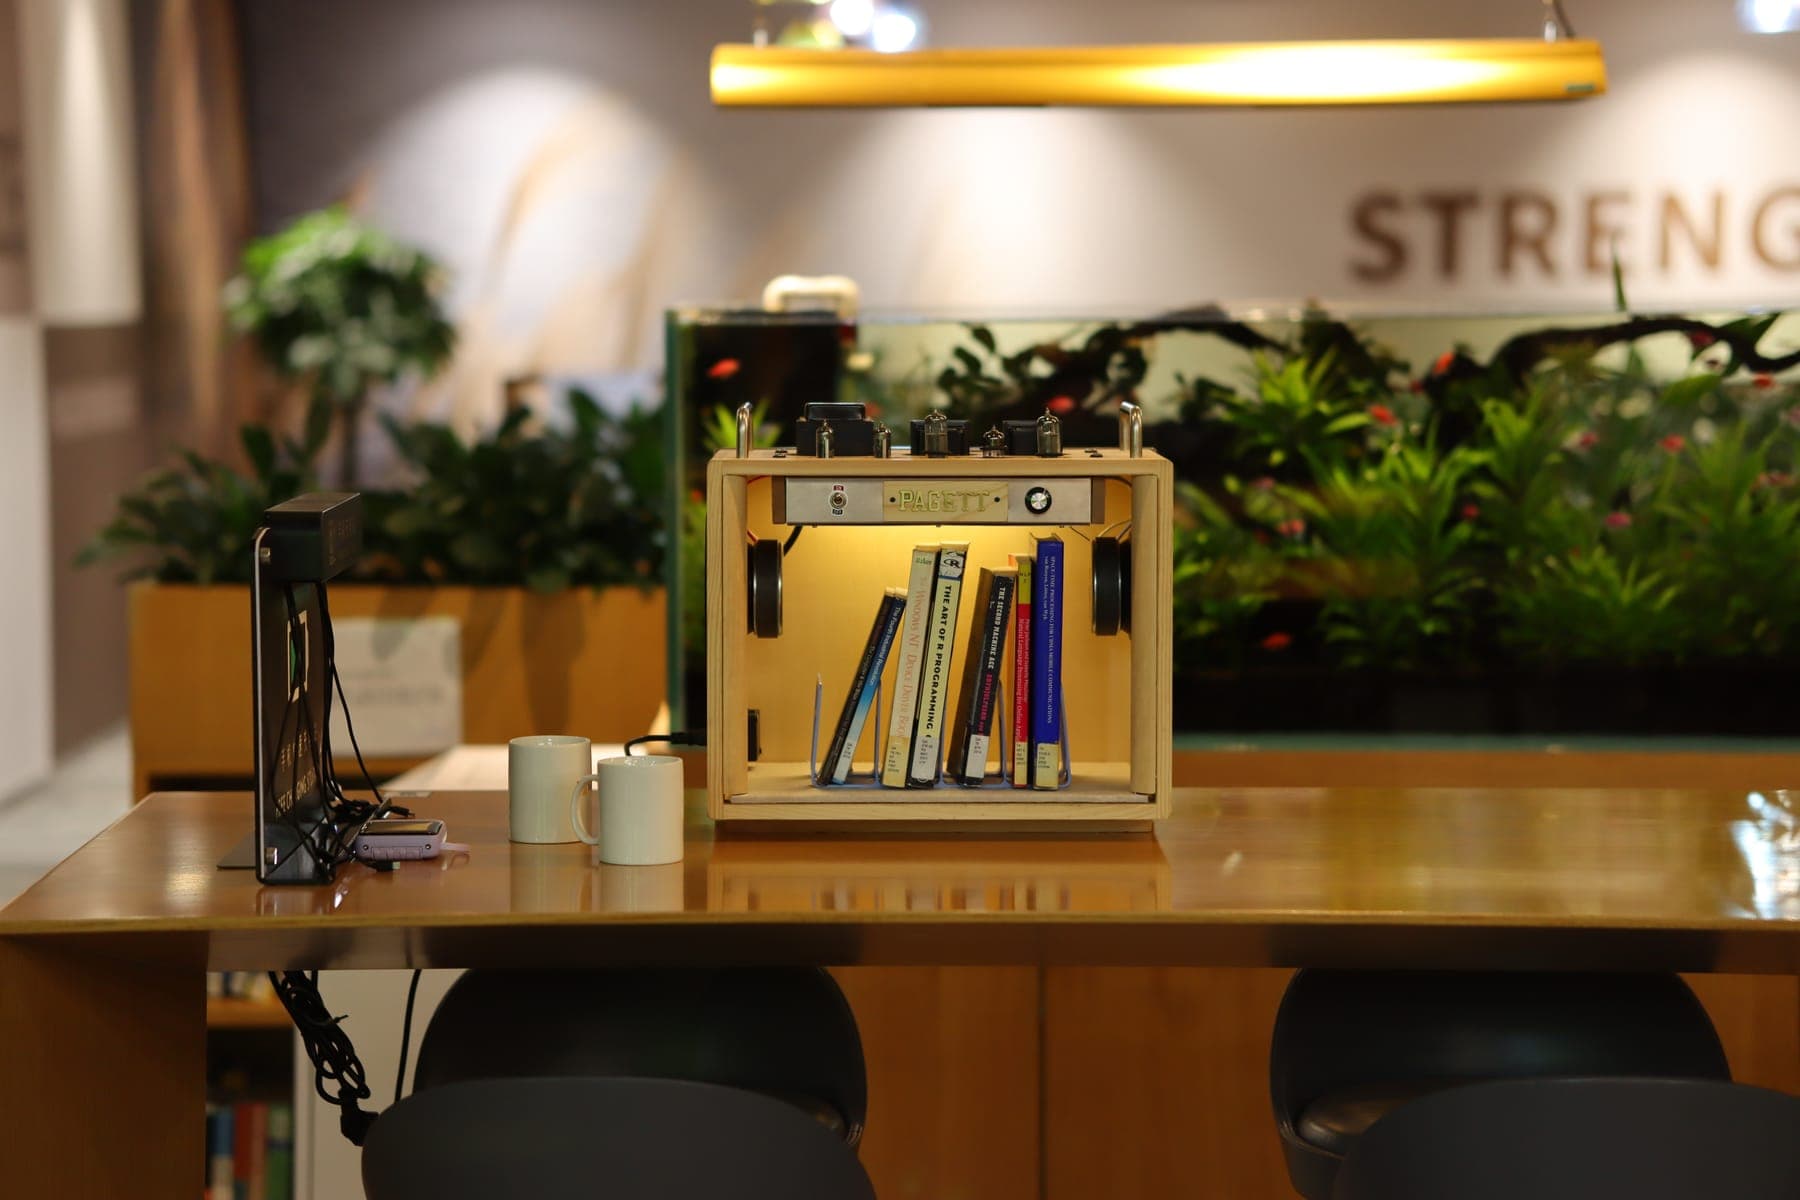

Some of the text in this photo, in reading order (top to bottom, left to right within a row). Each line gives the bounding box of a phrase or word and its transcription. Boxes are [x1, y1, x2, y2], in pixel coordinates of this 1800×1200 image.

[898, 489, 990, 512] PAGETT
[942, 585, 951, 604] THE
[997, 586, 1005, 599] THE
[939, 605, 949, 625] ART
[994, 600, 1003, 625] SECOND
[937, 627, 946, 640] OF
[989, 626, 1000, 656] MACHINE
[926, 652, 942, 729] PROGRAMMING
